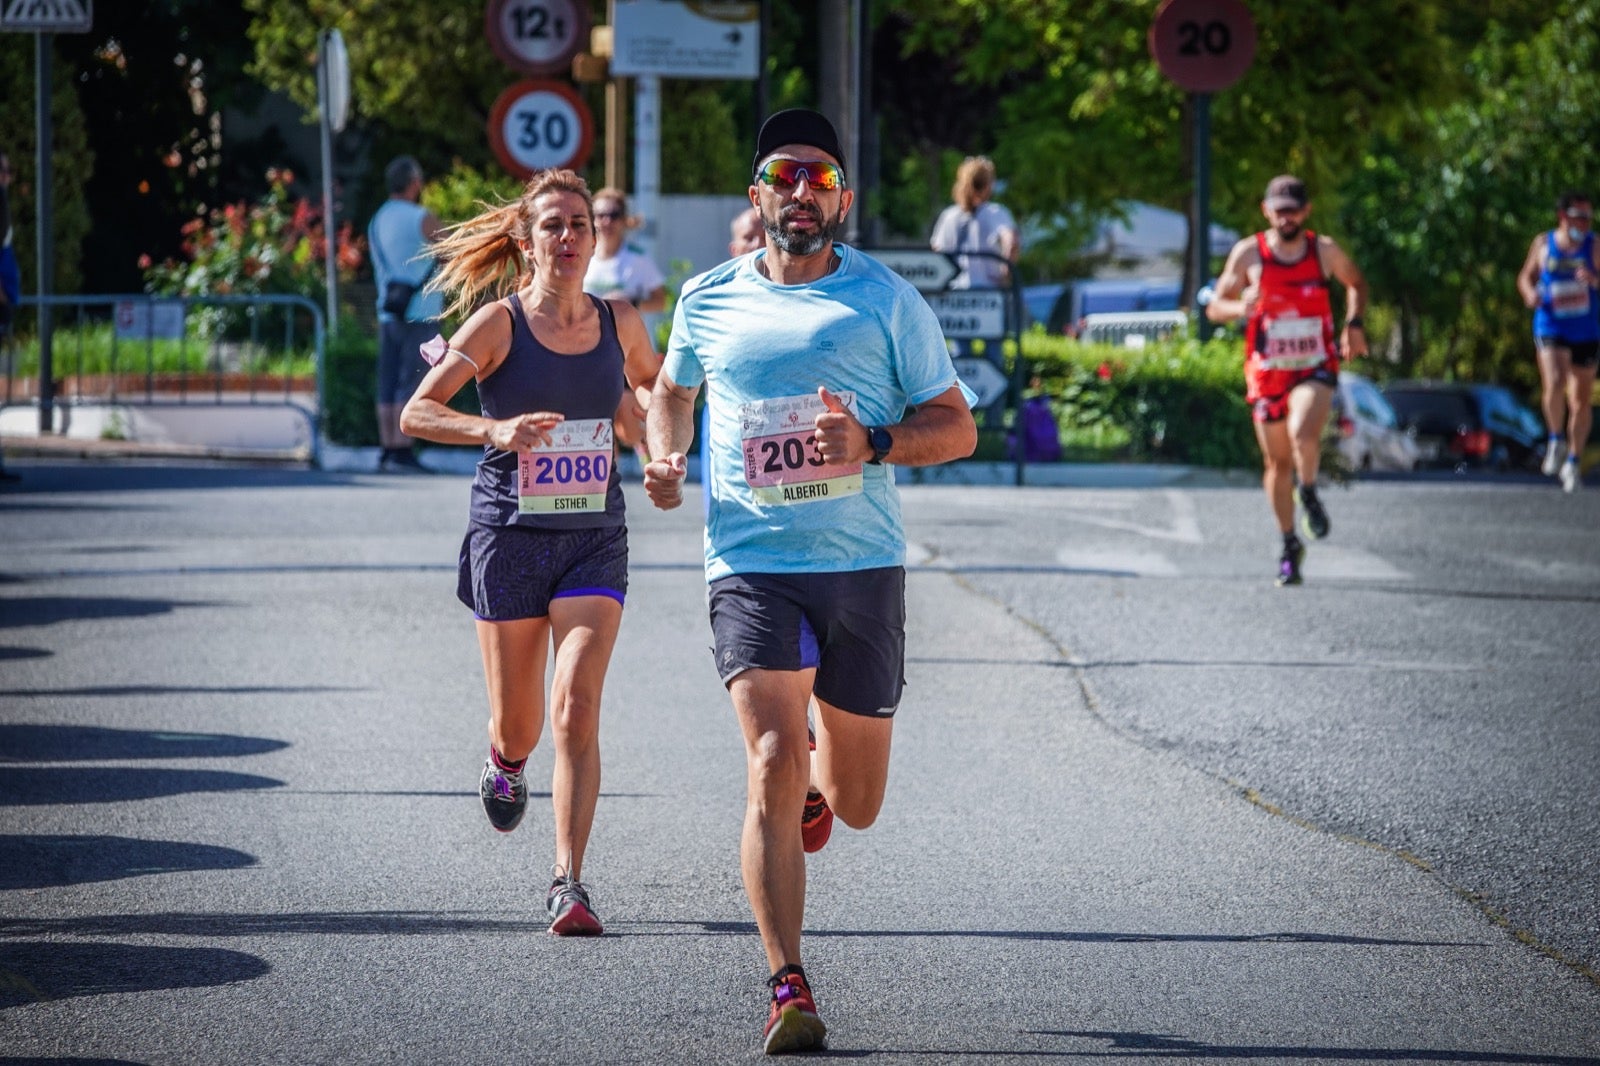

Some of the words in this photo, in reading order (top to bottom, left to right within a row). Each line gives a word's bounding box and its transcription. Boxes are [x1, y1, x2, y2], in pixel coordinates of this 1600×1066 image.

[1178, 21, 1231, 55] 20
[516, 110, 569, 149] 30
[747, 454, 757, 480] MASTER
[761, 434, 826, 473] 203
[535, 455, 608, 485] 2080
[554, 498, 588, 510] ESTHER
[783, 482, 828, 501] ALBERTO
